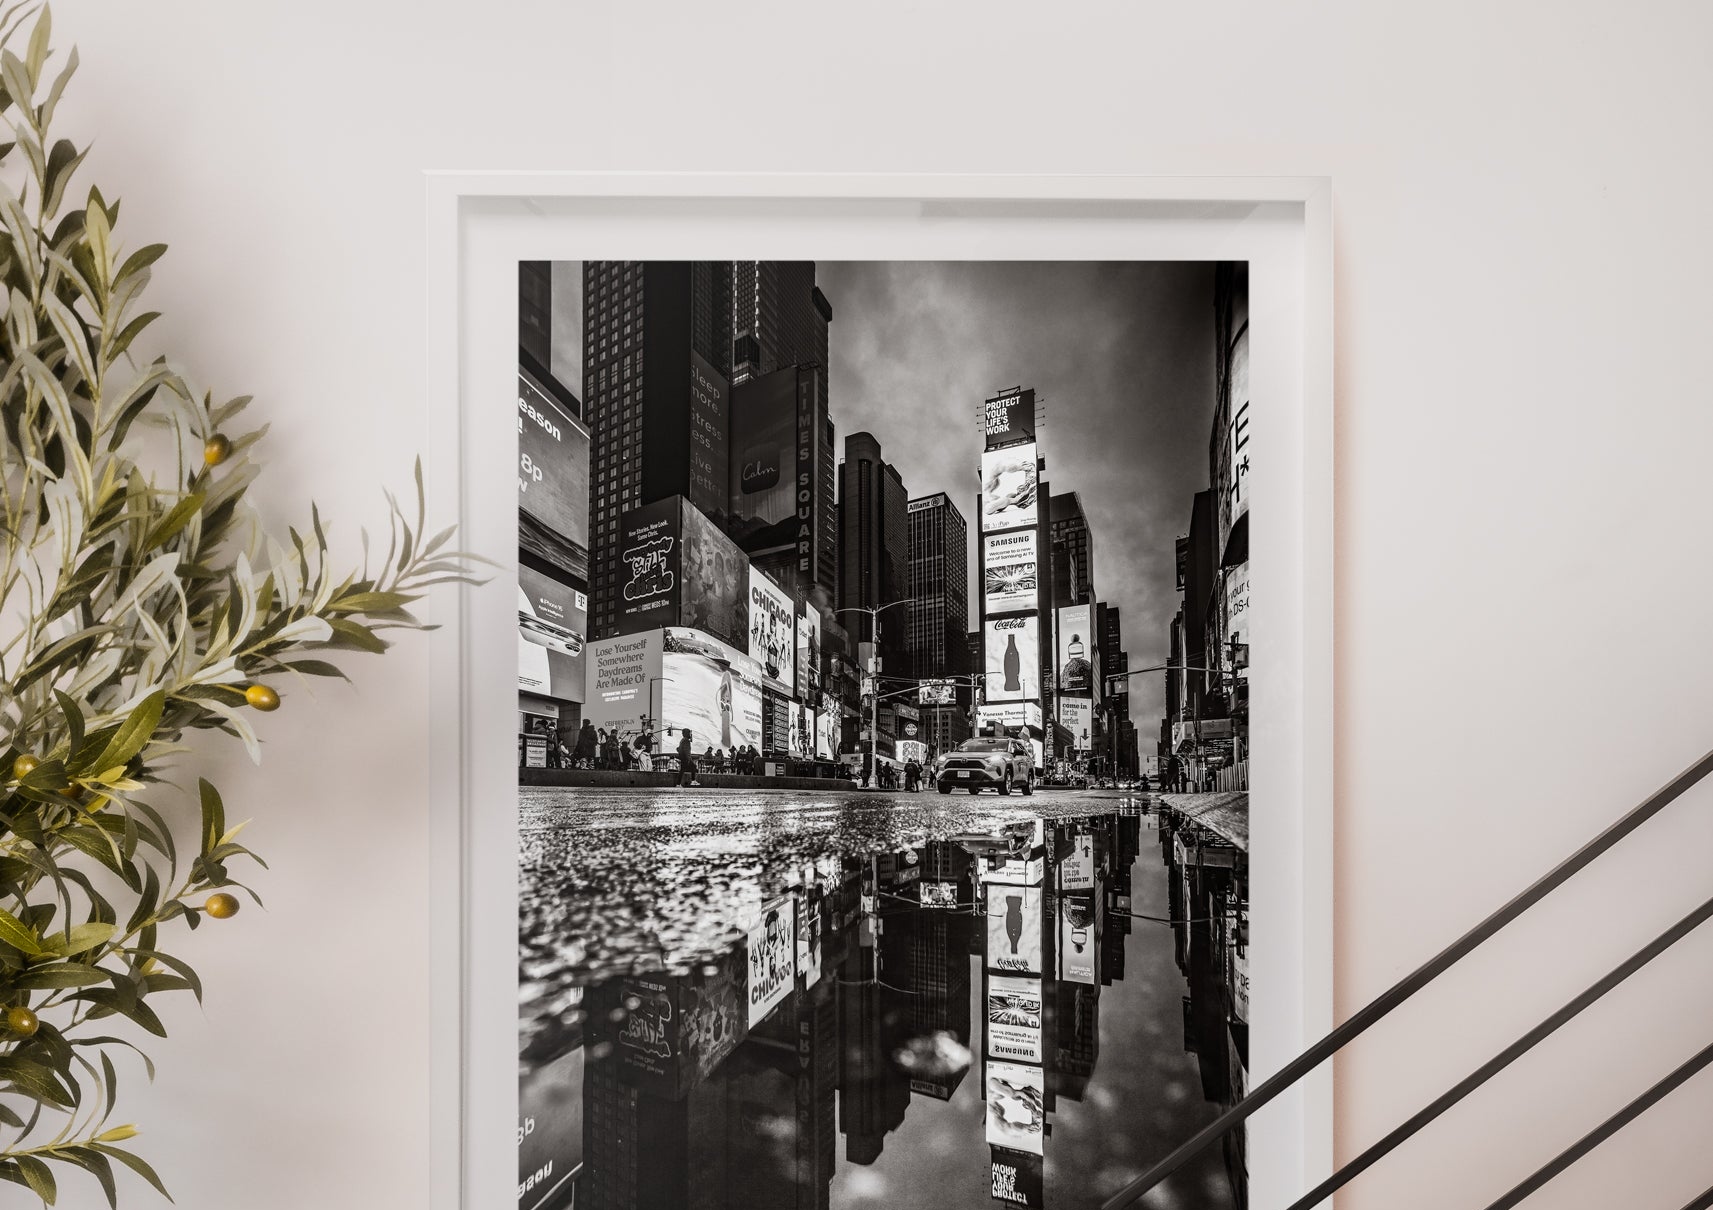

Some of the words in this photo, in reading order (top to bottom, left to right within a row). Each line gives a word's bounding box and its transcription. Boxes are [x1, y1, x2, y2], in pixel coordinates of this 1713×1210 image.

[986, 395, 1021, 411] PROTECT
[518, 397, 561, 442] eason
[799, 381, 811, 461] TIMES
[986, 407, 1007, 420] YOUR
[986, 415, 1008, 428] LIFE'S
[986, 422, 1010, 436] WORK
[521, 453, 543, 482] 8p
[743, 461, 777, 481] Calm
[909, 501, 930, 511] Allianz
[799, 472, 811, 571] SQUARE
[990, 535, 1030, 548] SAMSUNG
[989, 549, 1010, 557] Welcome
[1000, 552, 1023, 561] Samsung
[752, 586, 792, 630] CHICAGO
[994, 617, 1026, 631] Coca-Cola
[595, 647, 613, 658] Lose
[614, 638, 648, 654] Yourself
[597, 652, 645, 668] Somewhere
[598, 664, 643, 678] Daydreams
[596, 680, 610, 690] Are
[611, 677, 634, 688] Made
[635, 672, 647, 684] Of
[1080, 702, 1088, 710] in
